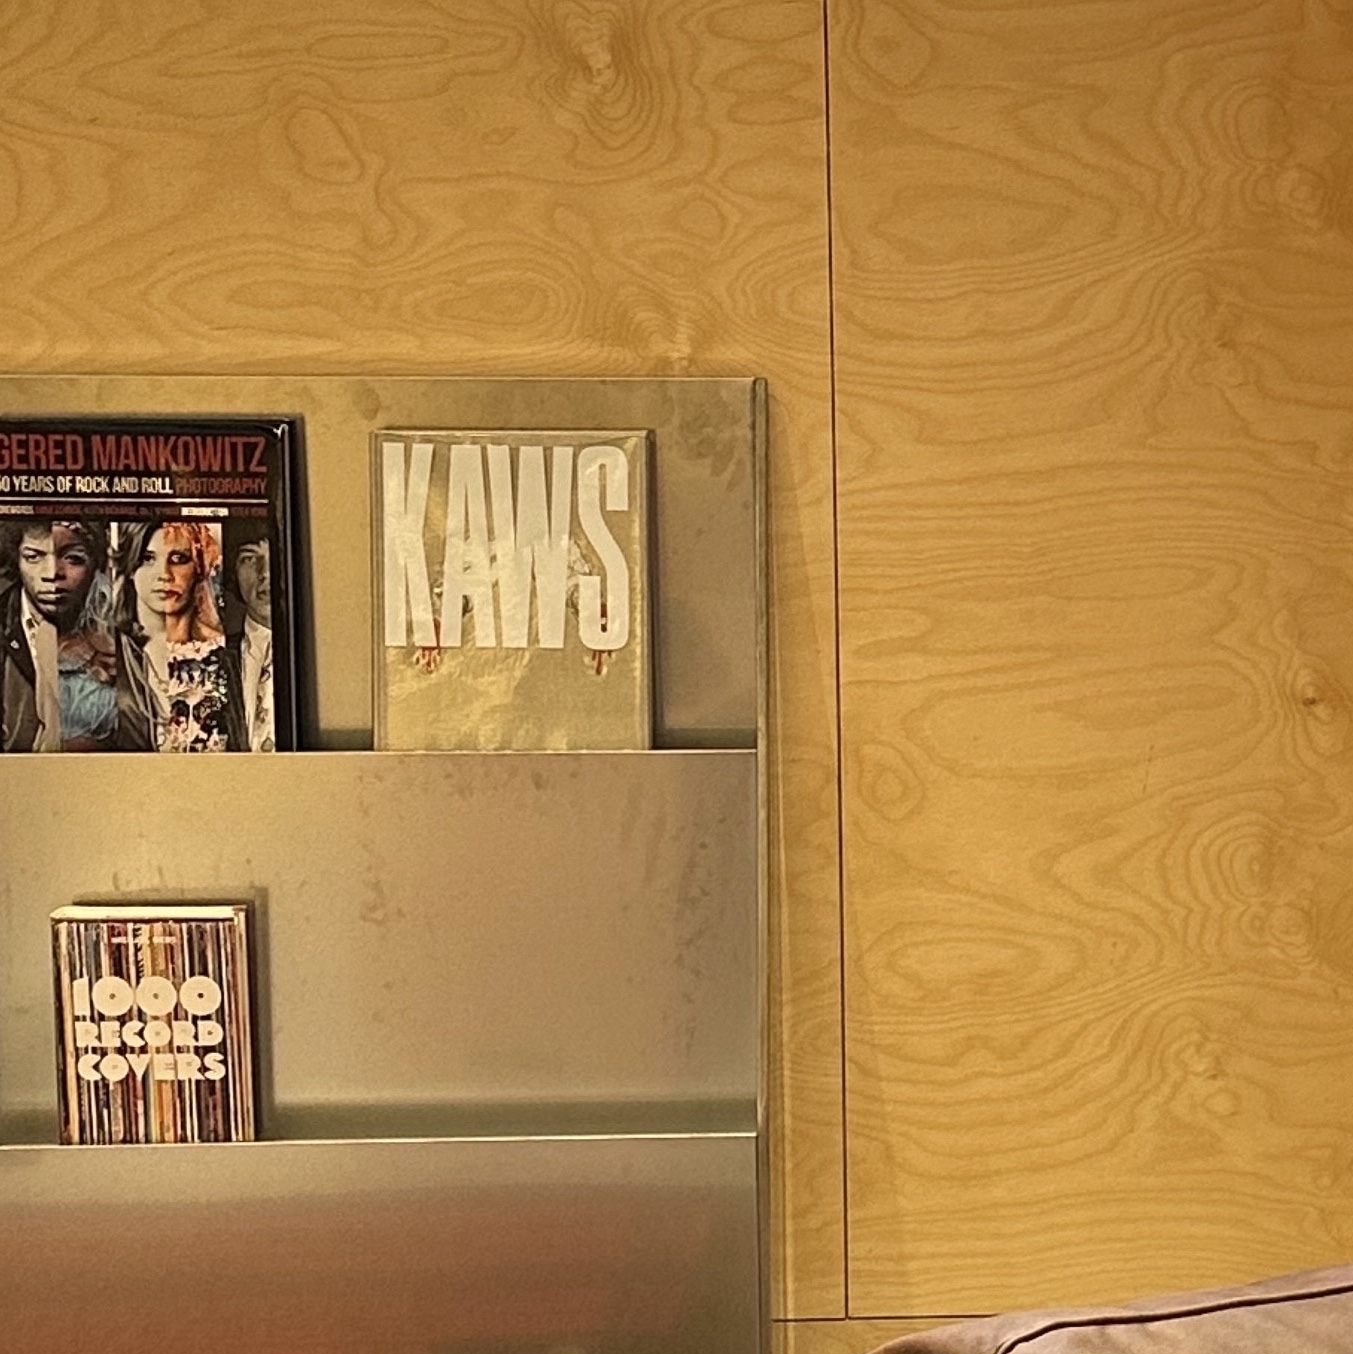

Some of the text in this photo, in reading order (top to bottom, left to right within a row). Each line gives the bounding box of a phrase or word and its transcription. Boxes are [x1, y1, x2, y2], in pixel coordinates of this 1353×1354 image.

[0, 433, 267, 472] GERED MANKOWITZ
[0, 475, 267, 494] 0 YEARS OF ROCK AND ROLL PHOTOGRAPHY
[382, 442, 629, 650] KAWS
[73, 976, 221, 1016] 1000
[75, 1021, 224, 1047] RECORD
[78, 1053, 226, 1081] COVERS
